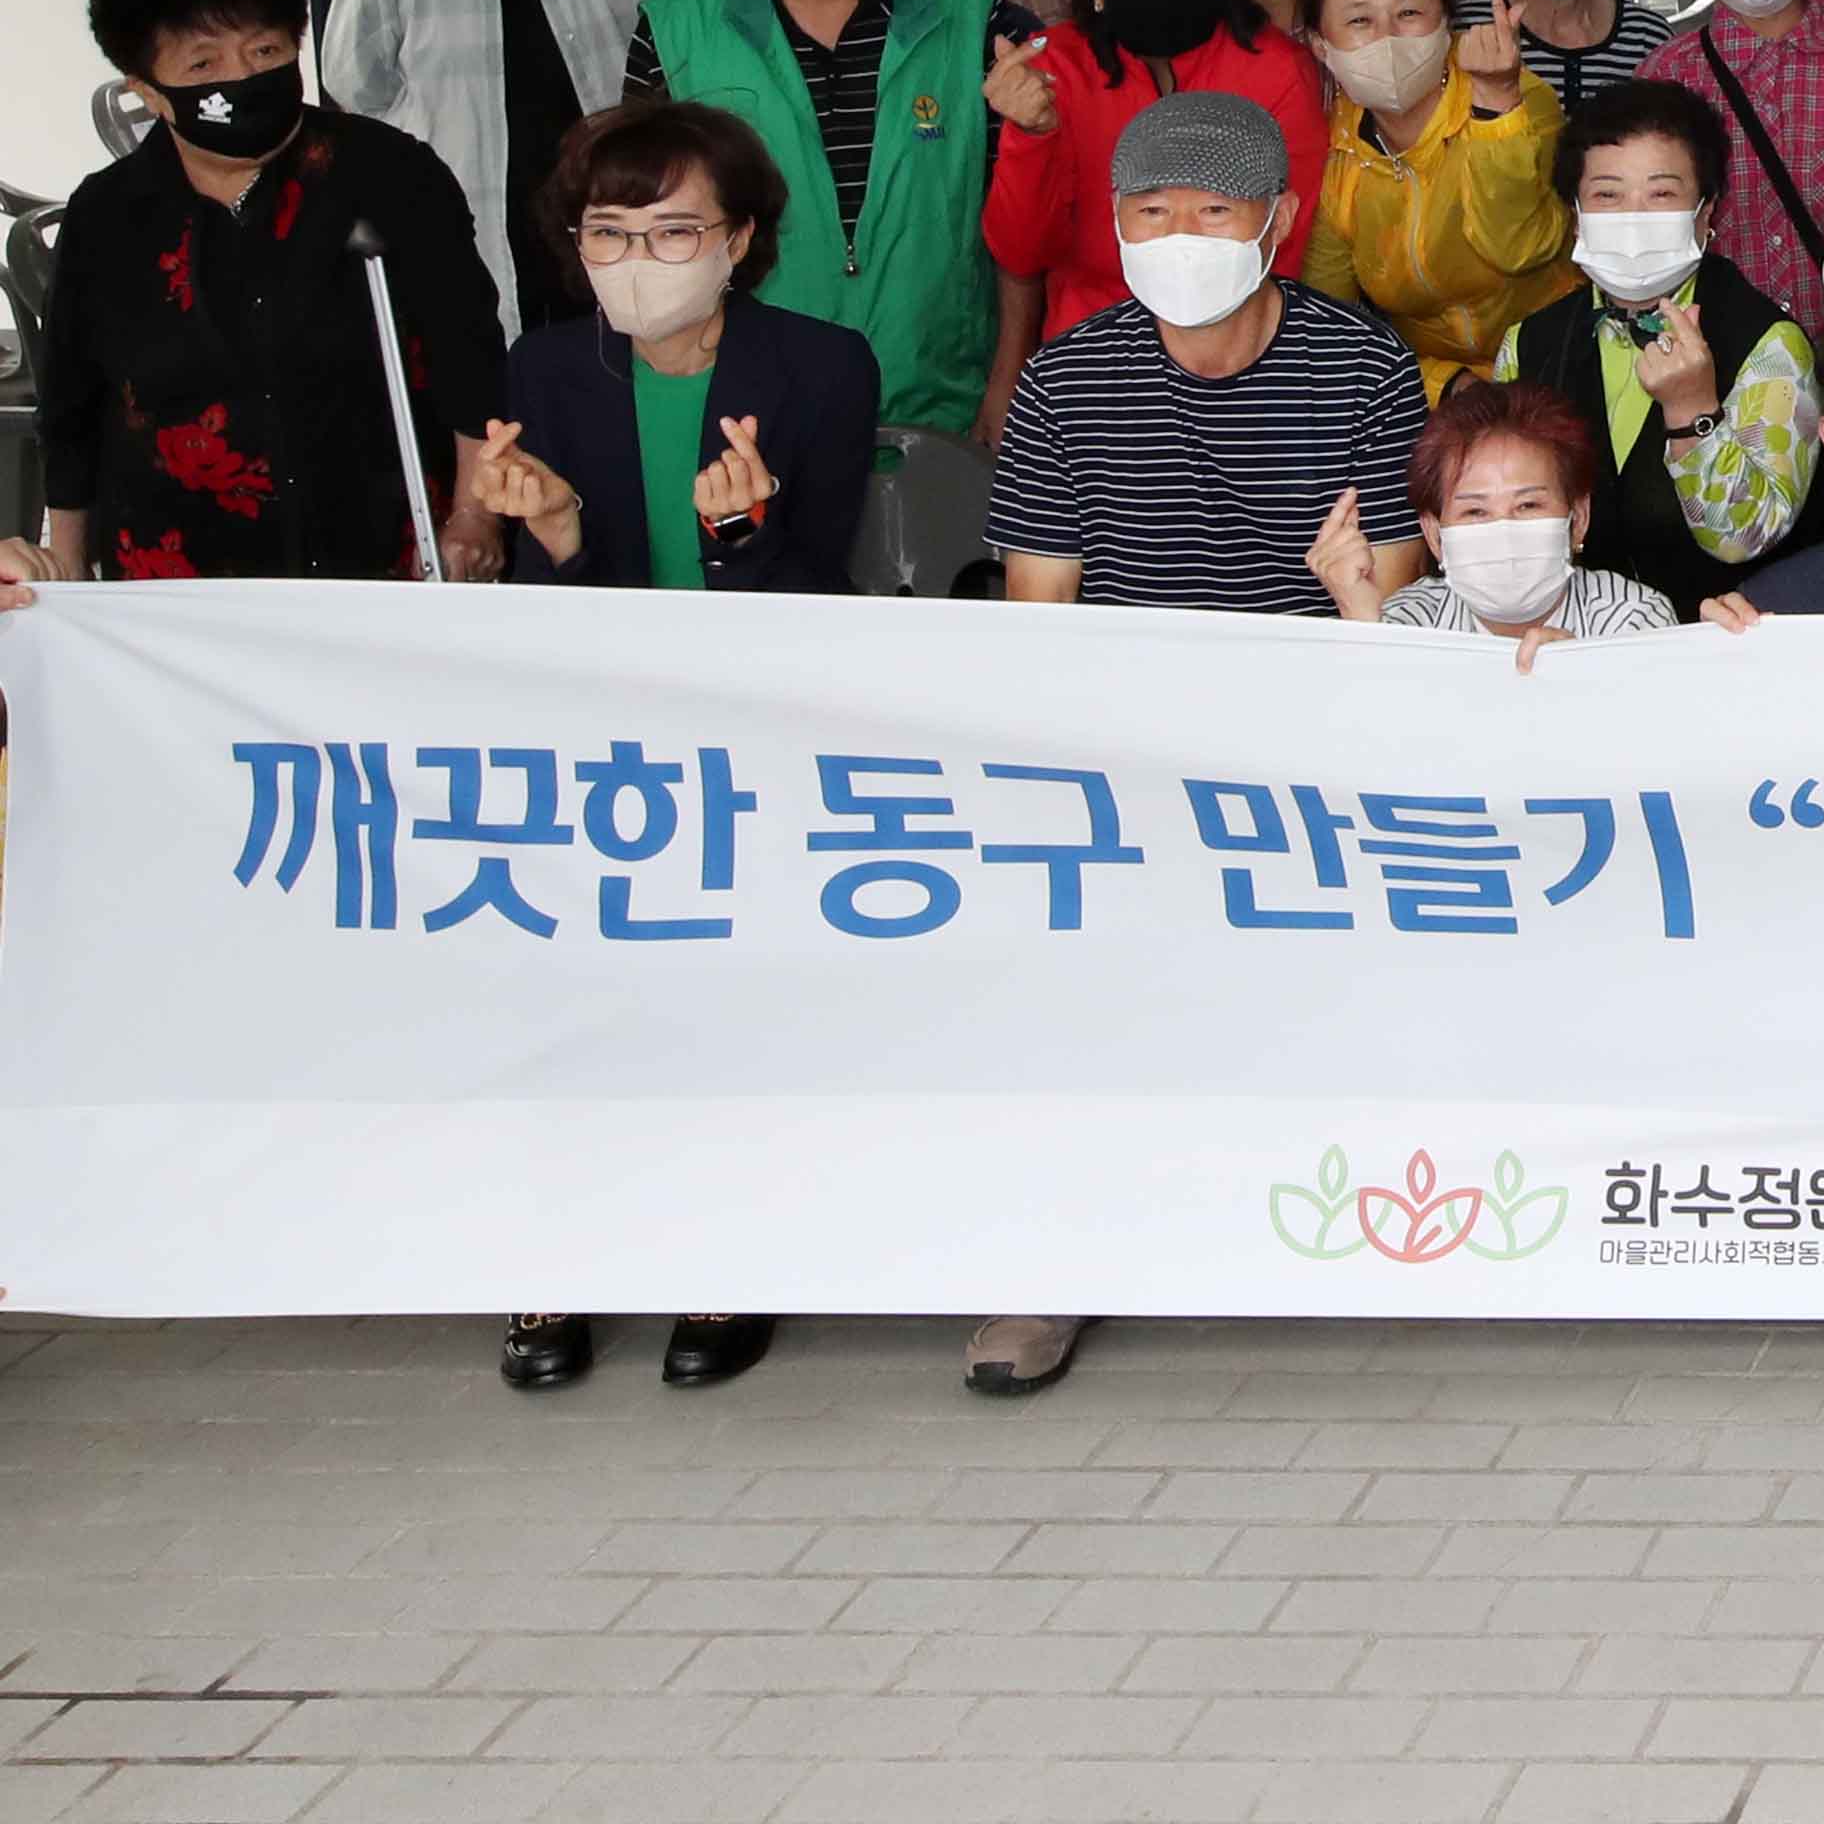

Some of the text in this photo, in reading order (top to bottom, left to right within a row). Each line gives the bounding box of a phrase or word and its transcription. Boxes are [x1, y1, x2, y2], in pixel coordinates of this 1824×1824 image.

[234, 742, 755, 939] 깨끗한
[808, 756, 1142, 937] 동구
[1185, 781, 1693, 937] 만들기
